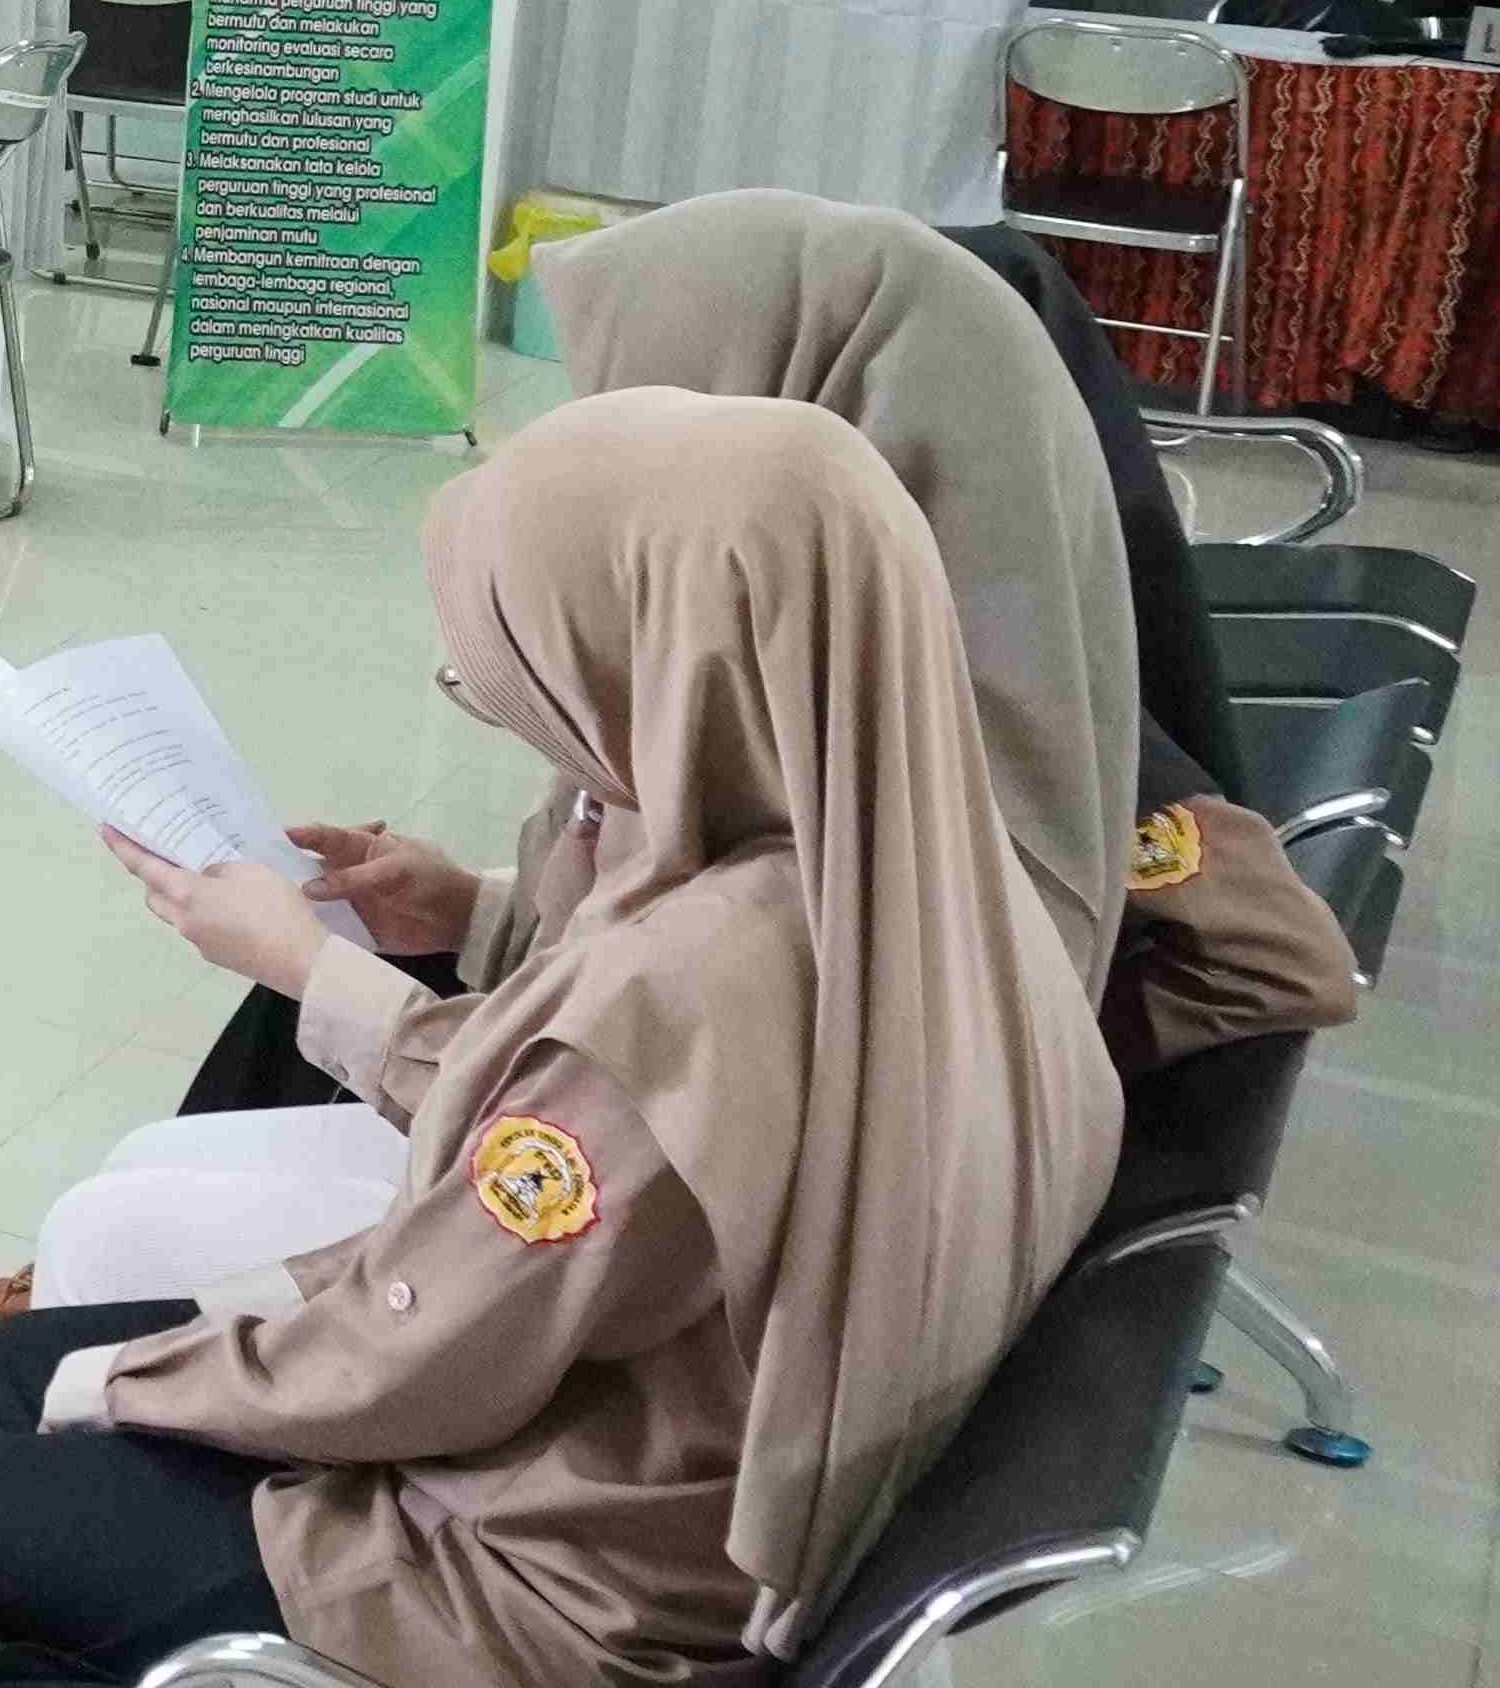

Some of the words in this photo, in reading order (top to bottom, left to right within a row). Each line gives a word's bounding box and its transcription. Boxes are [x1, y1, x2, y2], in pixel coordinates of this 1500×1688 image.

[400, 1, 437, 18] yang
[301, 18, 379, 35] melakukan
[207, 36, 279, 56] monitoring
[284, 41, 340, 56] evaluasi
[345, 45, 393, 59] secara
[281, 89, 340, 106] program
[344, 90, 377, 105] studi
[381, 93, 420, 108] untuk
[203, 107, 299, 126] menghasilkan
[302, 112, 350, 128] lulusan
[355, 118, 393, 133] yang
[201, 131, 257, 146] bermutu
[261, 133, 289, 147] dan
[293, 134, 370, 152] profesional
[201, 154, 301, 172] Melaksanakan
[305, 159, 332, 174] tata
[336, 160, 381, 176] kelola
[316, 187, 351, 201] yang
[356, 186, 436, 203] profesional
[197, 202, 223, 216] dan
[226, 202, 303, 220] berkualitas
[196, 225, 278, 242] penjaminan
[282, 230, 317, 243] mutu
[194, 249, 282, 268] Membangun
[286, 252, 359, 270] kemitraan
[364, 254, 419, 275] dengan
[191, 296, 250, 312] nasional
[254, 301, 311, 316] maupun
[315, 300, 409, 319] internasional
[191, 318, 236, 335] dalam
[346, 326, 403, 343] kualitas
[190, 345, 261, 361] perguruan
